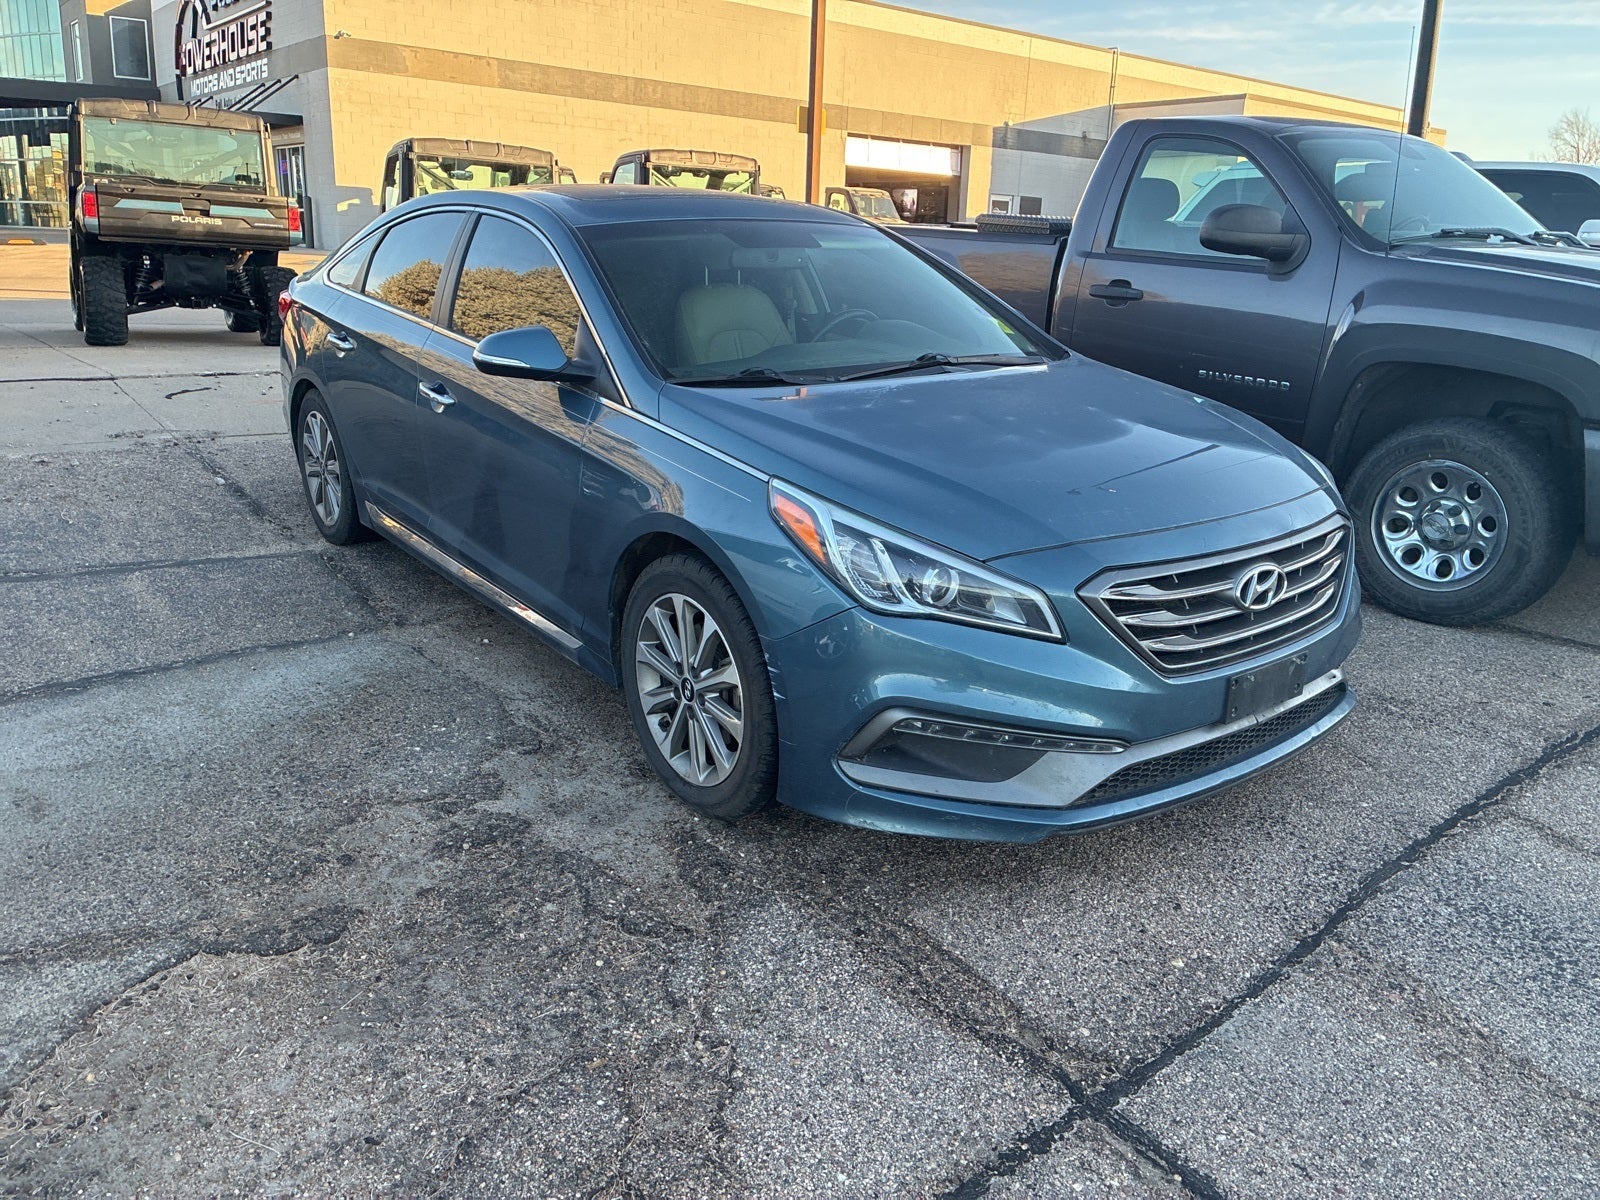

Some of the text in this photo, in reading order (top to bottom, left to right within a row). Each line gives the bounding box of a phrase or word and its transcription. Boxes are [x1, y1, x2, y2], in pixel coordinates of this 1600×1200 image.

[190, 57, 268, 97] MOTORS AND SPORTS
[171, 215, 222, 225] POLARIS
[1198, 369, 1290, 390] SILVERADO
